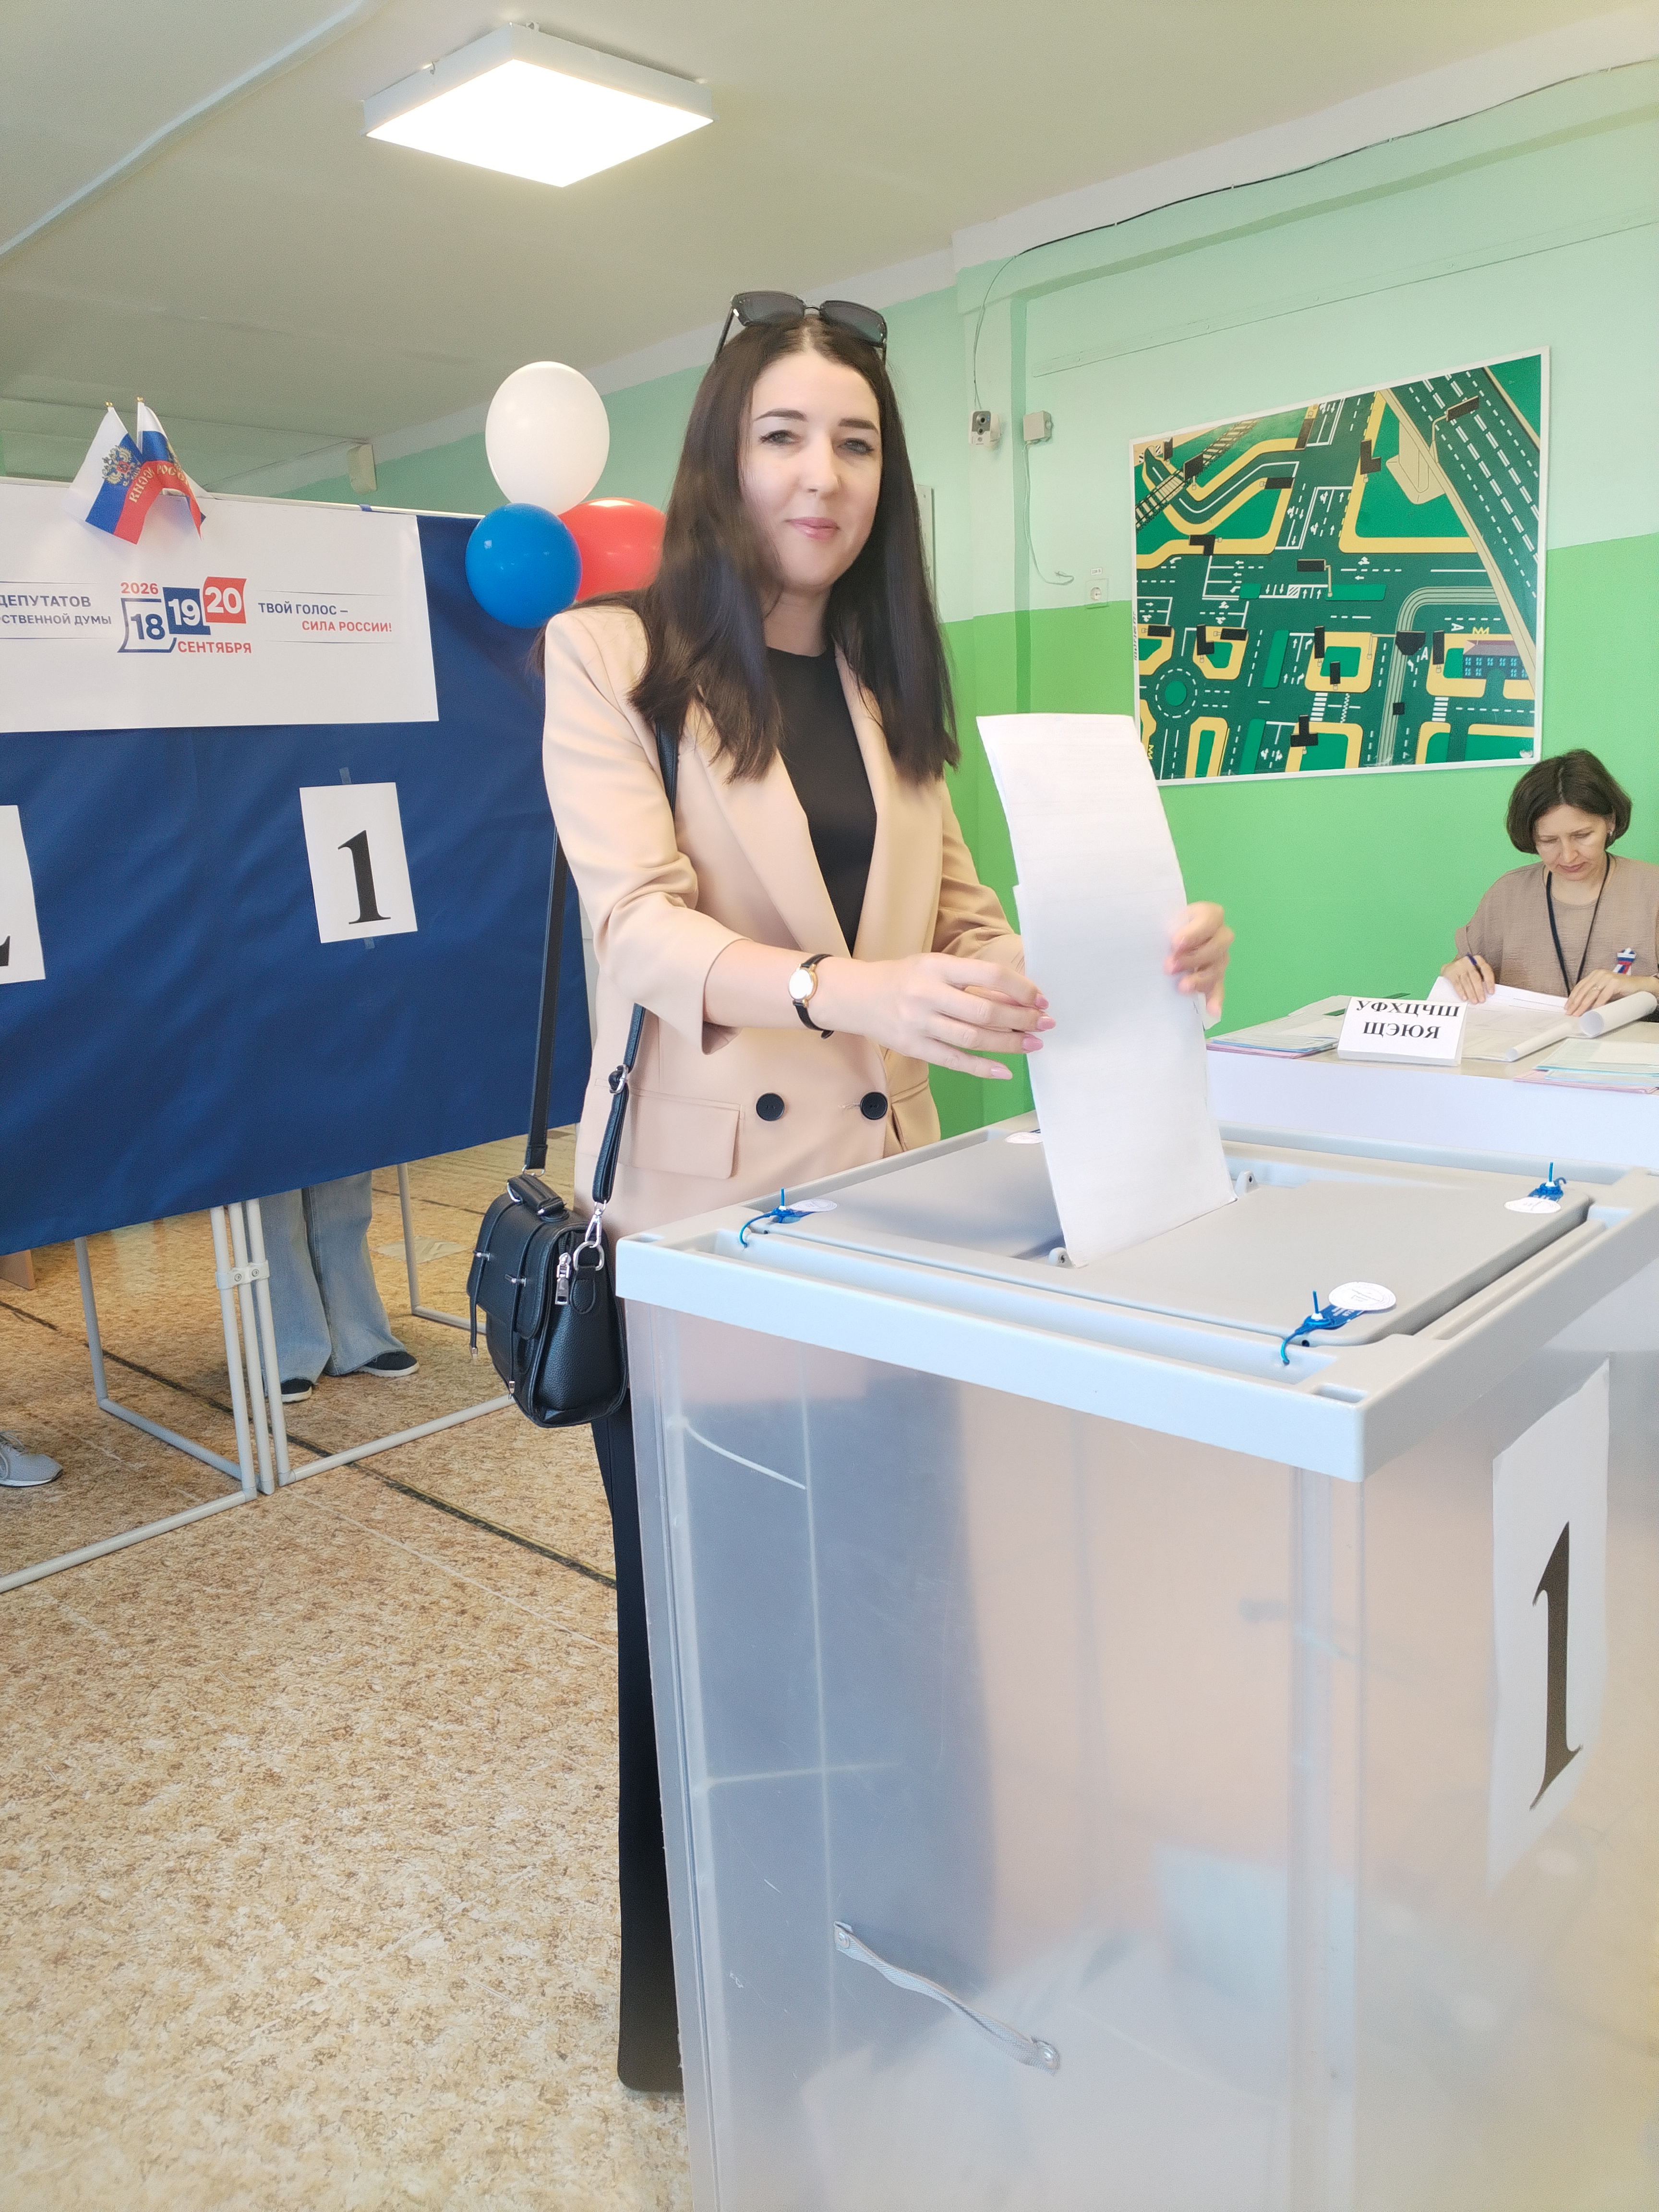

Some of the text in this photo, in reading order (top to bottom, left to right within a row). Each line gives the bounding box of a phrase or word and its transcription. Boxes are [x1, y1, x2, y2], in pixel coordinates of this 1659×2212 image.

[120, 582, 159, 595] 2026
[131, 586, 242, 640] 18 19 20
[258, 601, 292, 614] ТВОЙ
[296, 604, 337, 615] ГОЛОС
[0, 613, 111, 625] СТВЕННОЙ ДУМЫ
[302, 620, 392, 632] СИЛА РОССИИ!
[178, 641, 252, 653] СЕНТЯБРЯ
[338, 830, 391, 925] 1
[1356, 1000, 1461, 1017] УФХЦЧШ
[1363, 1022, 1442, 1039] ЩЭЮЯ
[1530, 1521, 1584, 1812] 1
